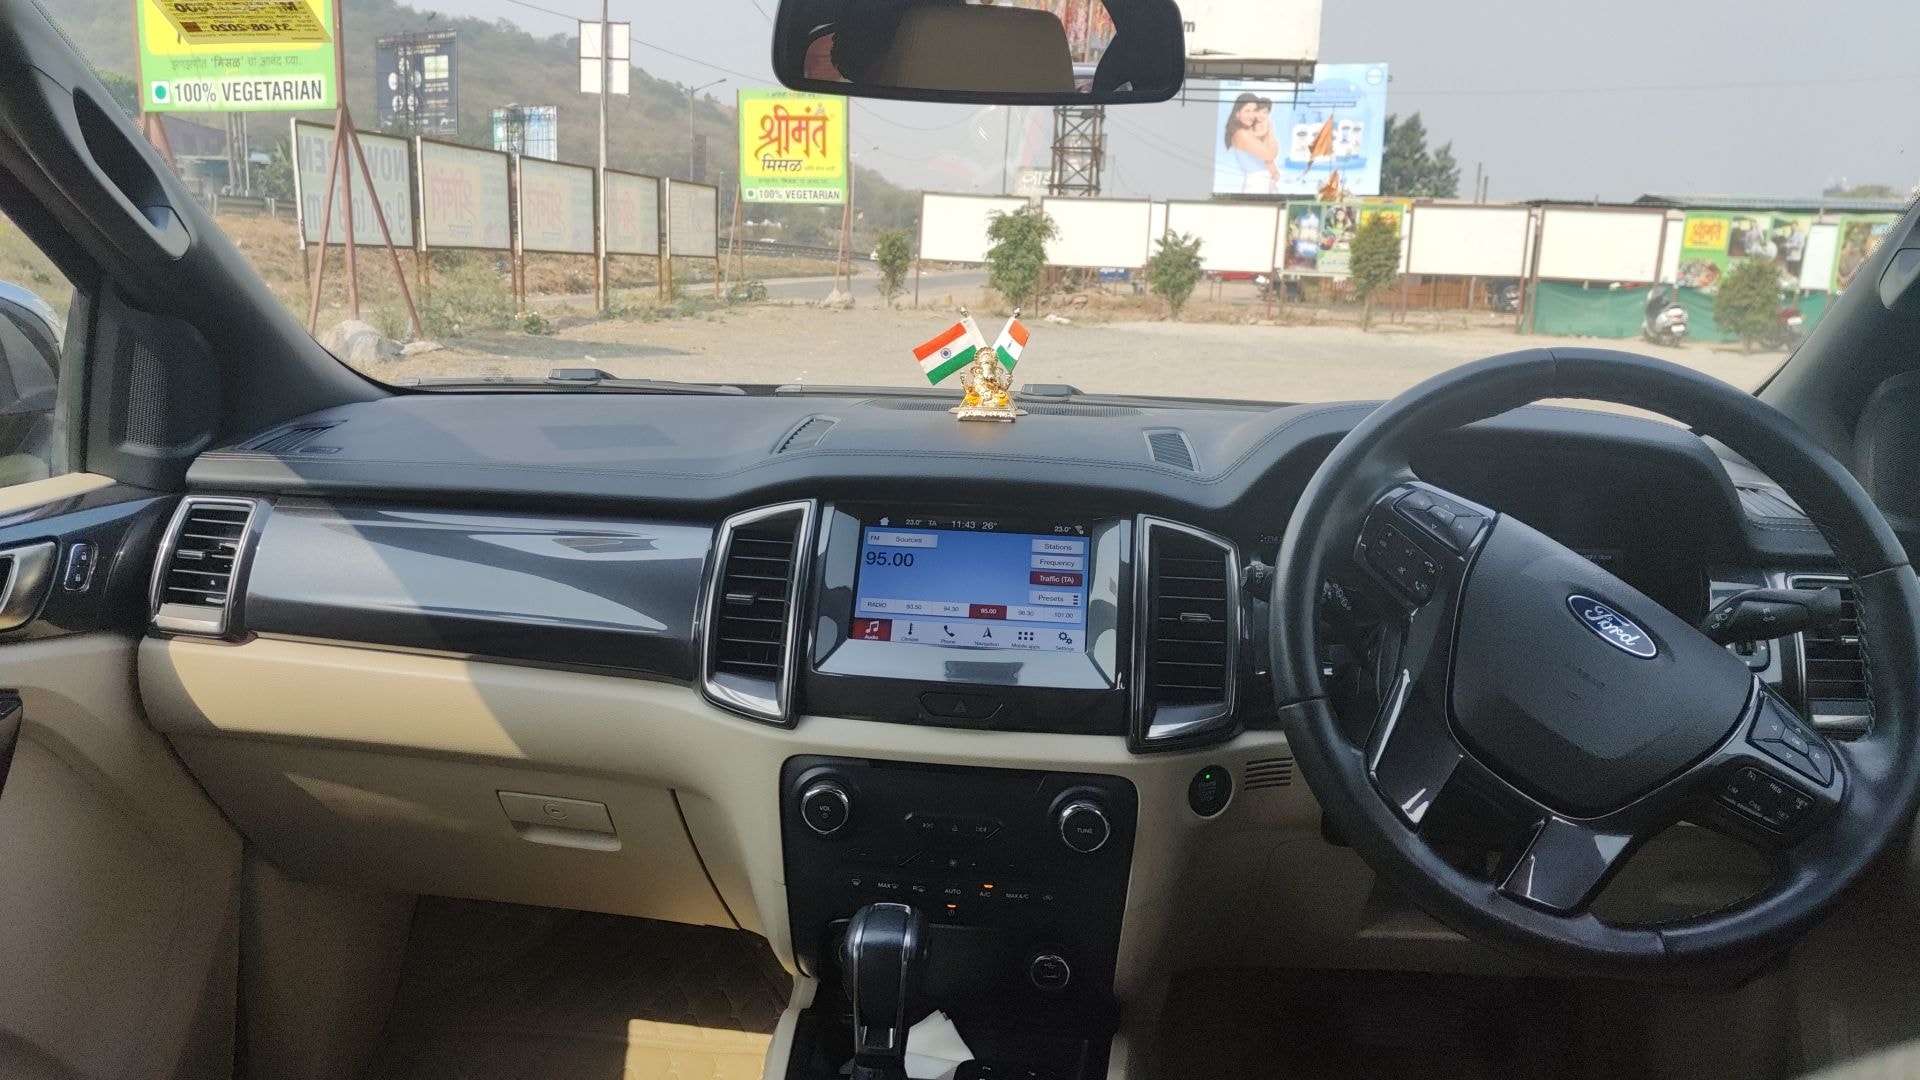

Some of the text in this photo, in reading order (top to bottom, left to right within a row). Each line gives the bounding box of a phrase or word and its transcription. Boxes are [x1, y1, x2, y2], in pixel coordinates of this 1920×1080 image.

[174, 79, 322, 103] 100% VEGETARIAN
[754, 104, 830, 160] श्रीमंत
[762, 153, 803, 172] मिसळ
[759, 189, 840, 200] 100% VEGETARIAN
[928, 519, 937, 527] TA
[951, 520, 976, 530] 11:43
[981, 521, 998, 530] 26°
[1054, 525, 1072, 533] 23.0°
[895, 535, 923, 545] Sources
[1044, 543, 1072, 551] Stations
[865, 551, 914, 567] 95.00
[1039, 558, 1075, 568] Frequency
[1039, 574, 1075, 584] Traffic (TA)
[1038, 594, 1064, 603] Presets
[1583, 604, 1642, 647] Ford
[818, 805, 831, 813] VOL
[1076, 827, 1094, 836] TUNE
[877, 882, 891, 890] MAX
[944, 888, 962, 896] AUTO
